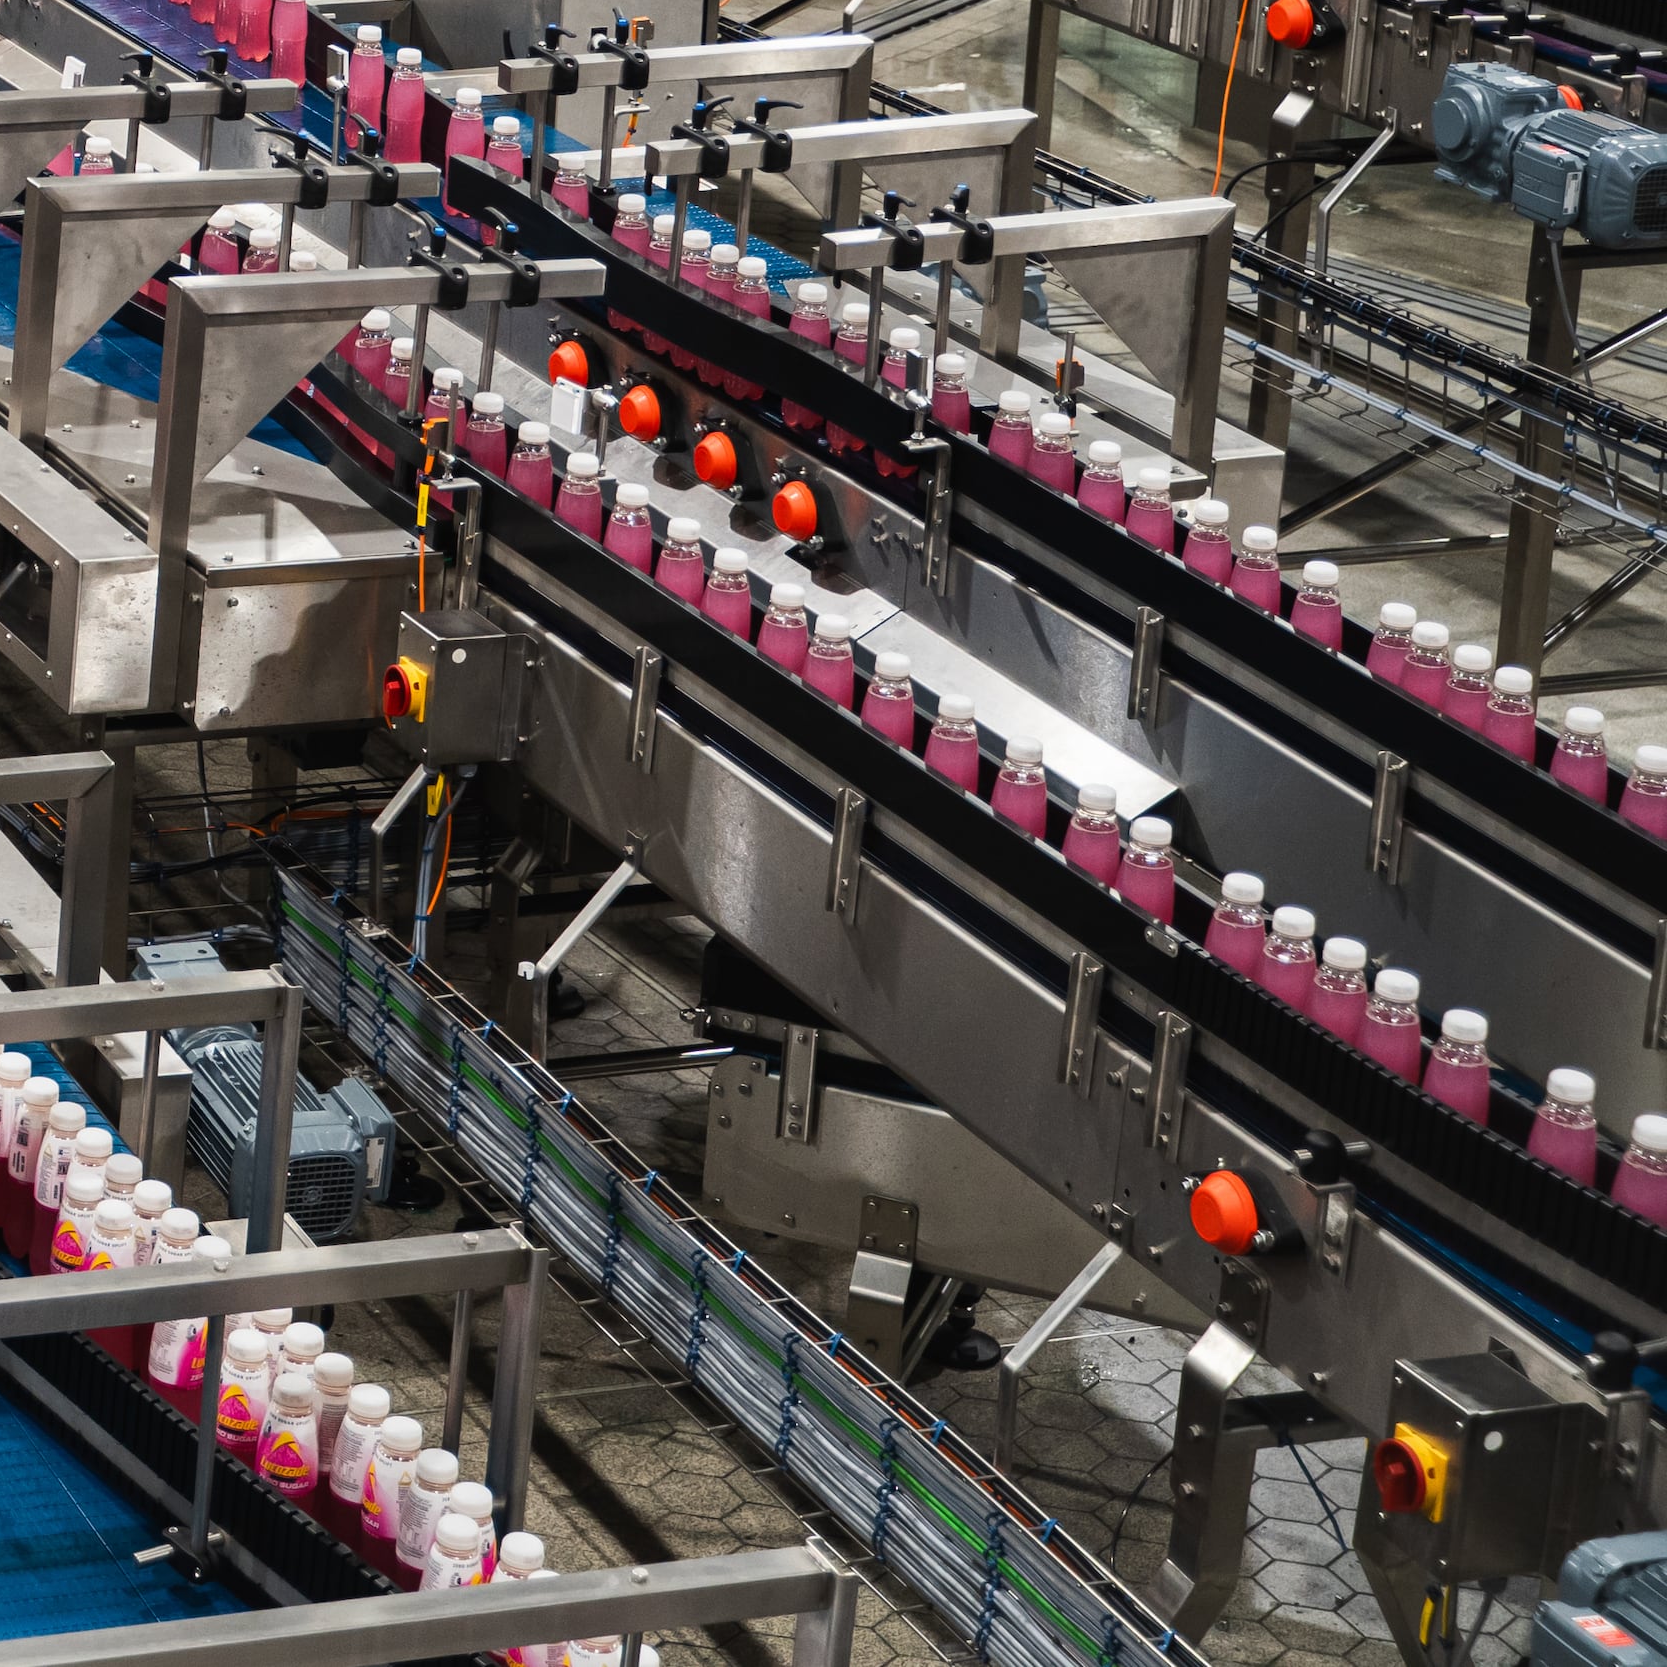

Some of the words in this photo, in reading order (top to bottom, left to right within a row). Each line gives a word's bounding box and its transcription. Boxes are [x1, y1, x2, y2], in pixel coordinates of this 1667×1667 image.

[226, 1433, 258, 1443] SUGAR
[260, 1455, 311, 1477] Lucozade
[279, 1481, 310, 1489] SUGAR
